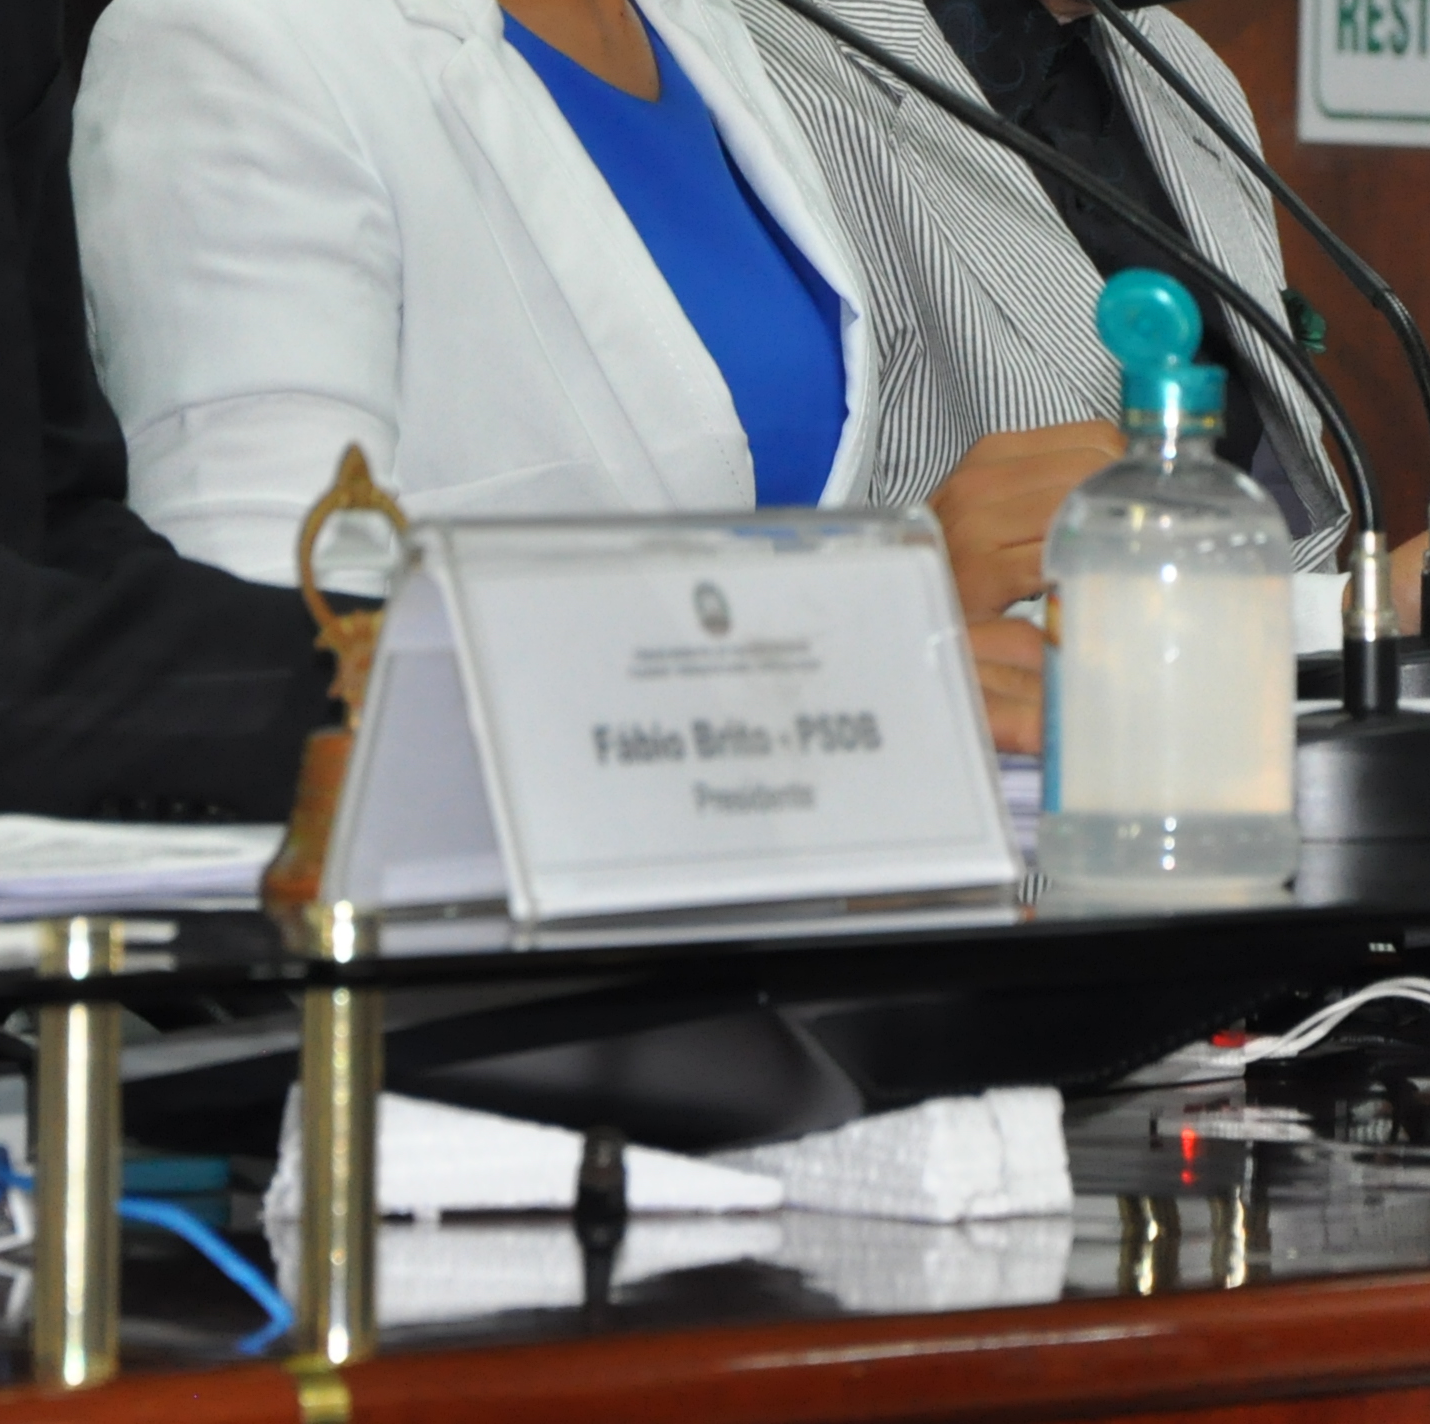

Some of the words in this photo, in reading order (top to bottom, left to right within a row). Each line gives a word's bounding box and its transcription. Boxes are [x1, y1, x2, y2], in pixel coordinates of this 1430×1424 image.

[592, 720, 685, 766] Fábio
[691, 717, 771, 762] Brito
[794, 709, 884, 754] PSDB
